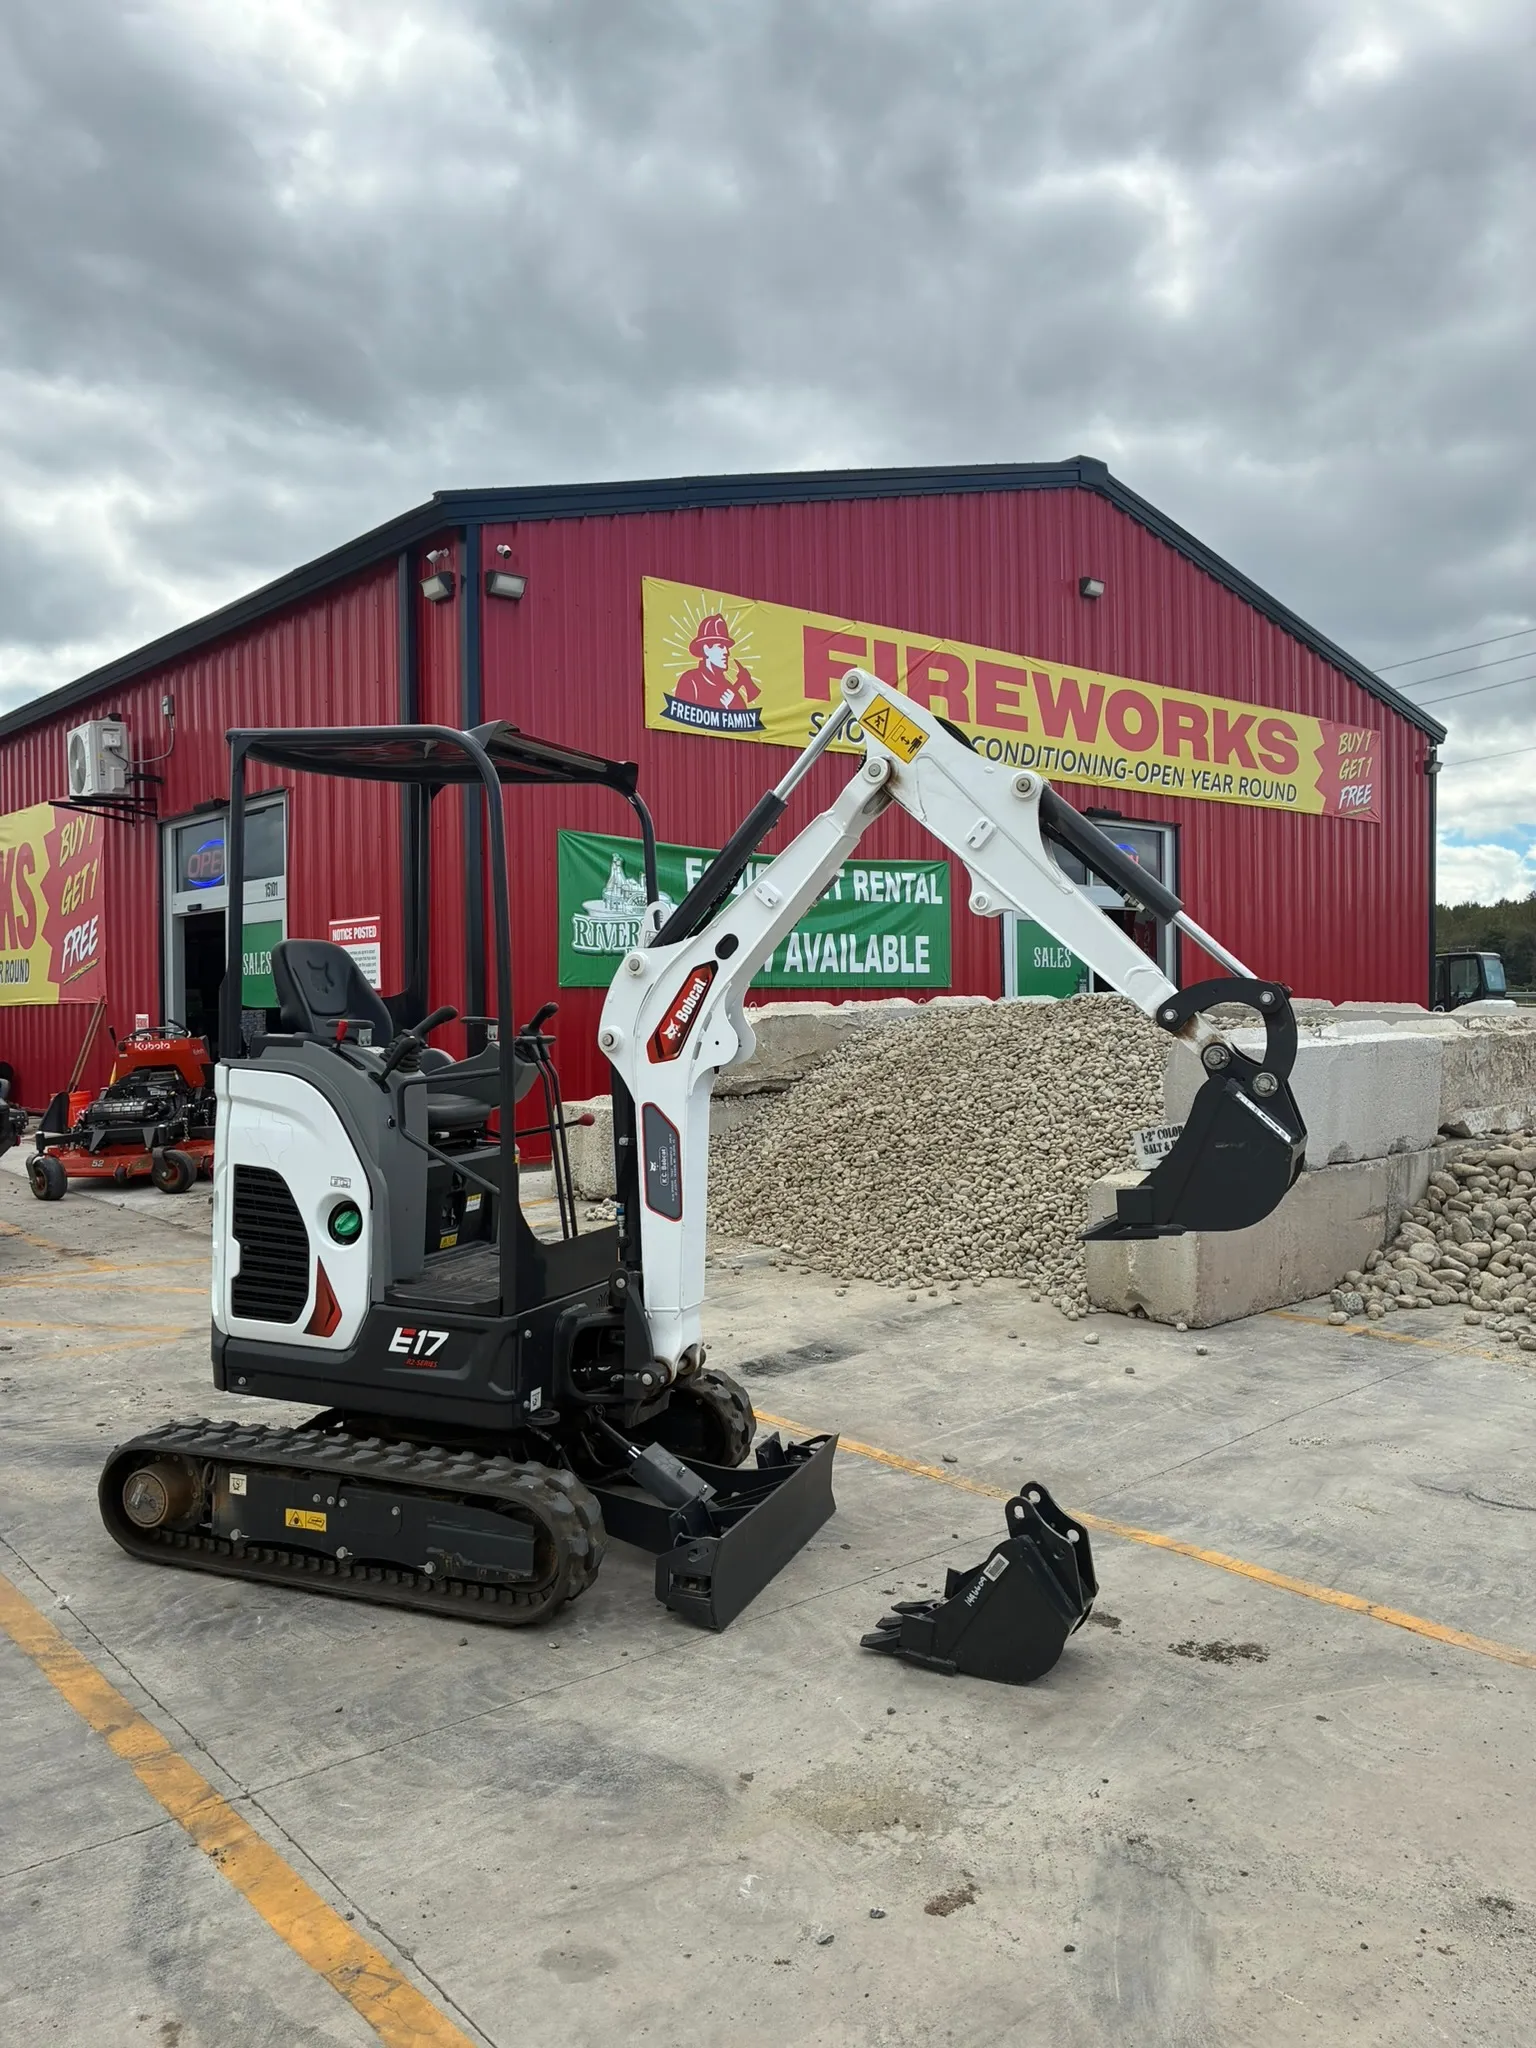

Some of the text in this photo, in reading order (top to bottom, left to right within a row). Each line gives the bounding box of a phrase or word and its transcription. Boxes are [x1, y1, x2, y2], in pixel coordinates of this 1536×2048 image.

[670, 700, 756, 728] FREEDOM FAMILY
[803, 624, 1299, 776] FIREWORKS
[1338, 730, 1372, 756] BUY 1
[1339, 757, 1373, 780] GET 1
[1191, 769, 1233, 794] YEAR
[1239, 776, 1297, 802] ROUND
[1338, 784, 1373, 810] FREE
[59, 811, 97, 868] BUY 1
[60, 858, 98, 916] GET 1
[853, 869, 943, 904] RENTAL
[61, 914, 99, 975] FREE
[332, 925, 377, 942] NOTICE POSTED
[243, 951, 272, 976] SALES
[783, 932, 931, 973] AVAILABLE
[1034, 946, 1072, 968] SALES
[5, 958, 30, 983] ROUND
[675, 977, 707, 1024] Bobcat
[134, 1041, 170, 1051] Kubota
[1143, 1142, 1162, 1155] SALT
[1164, 1141, 1171, 1151] &
[388, 1326, 450, 1356] E17
